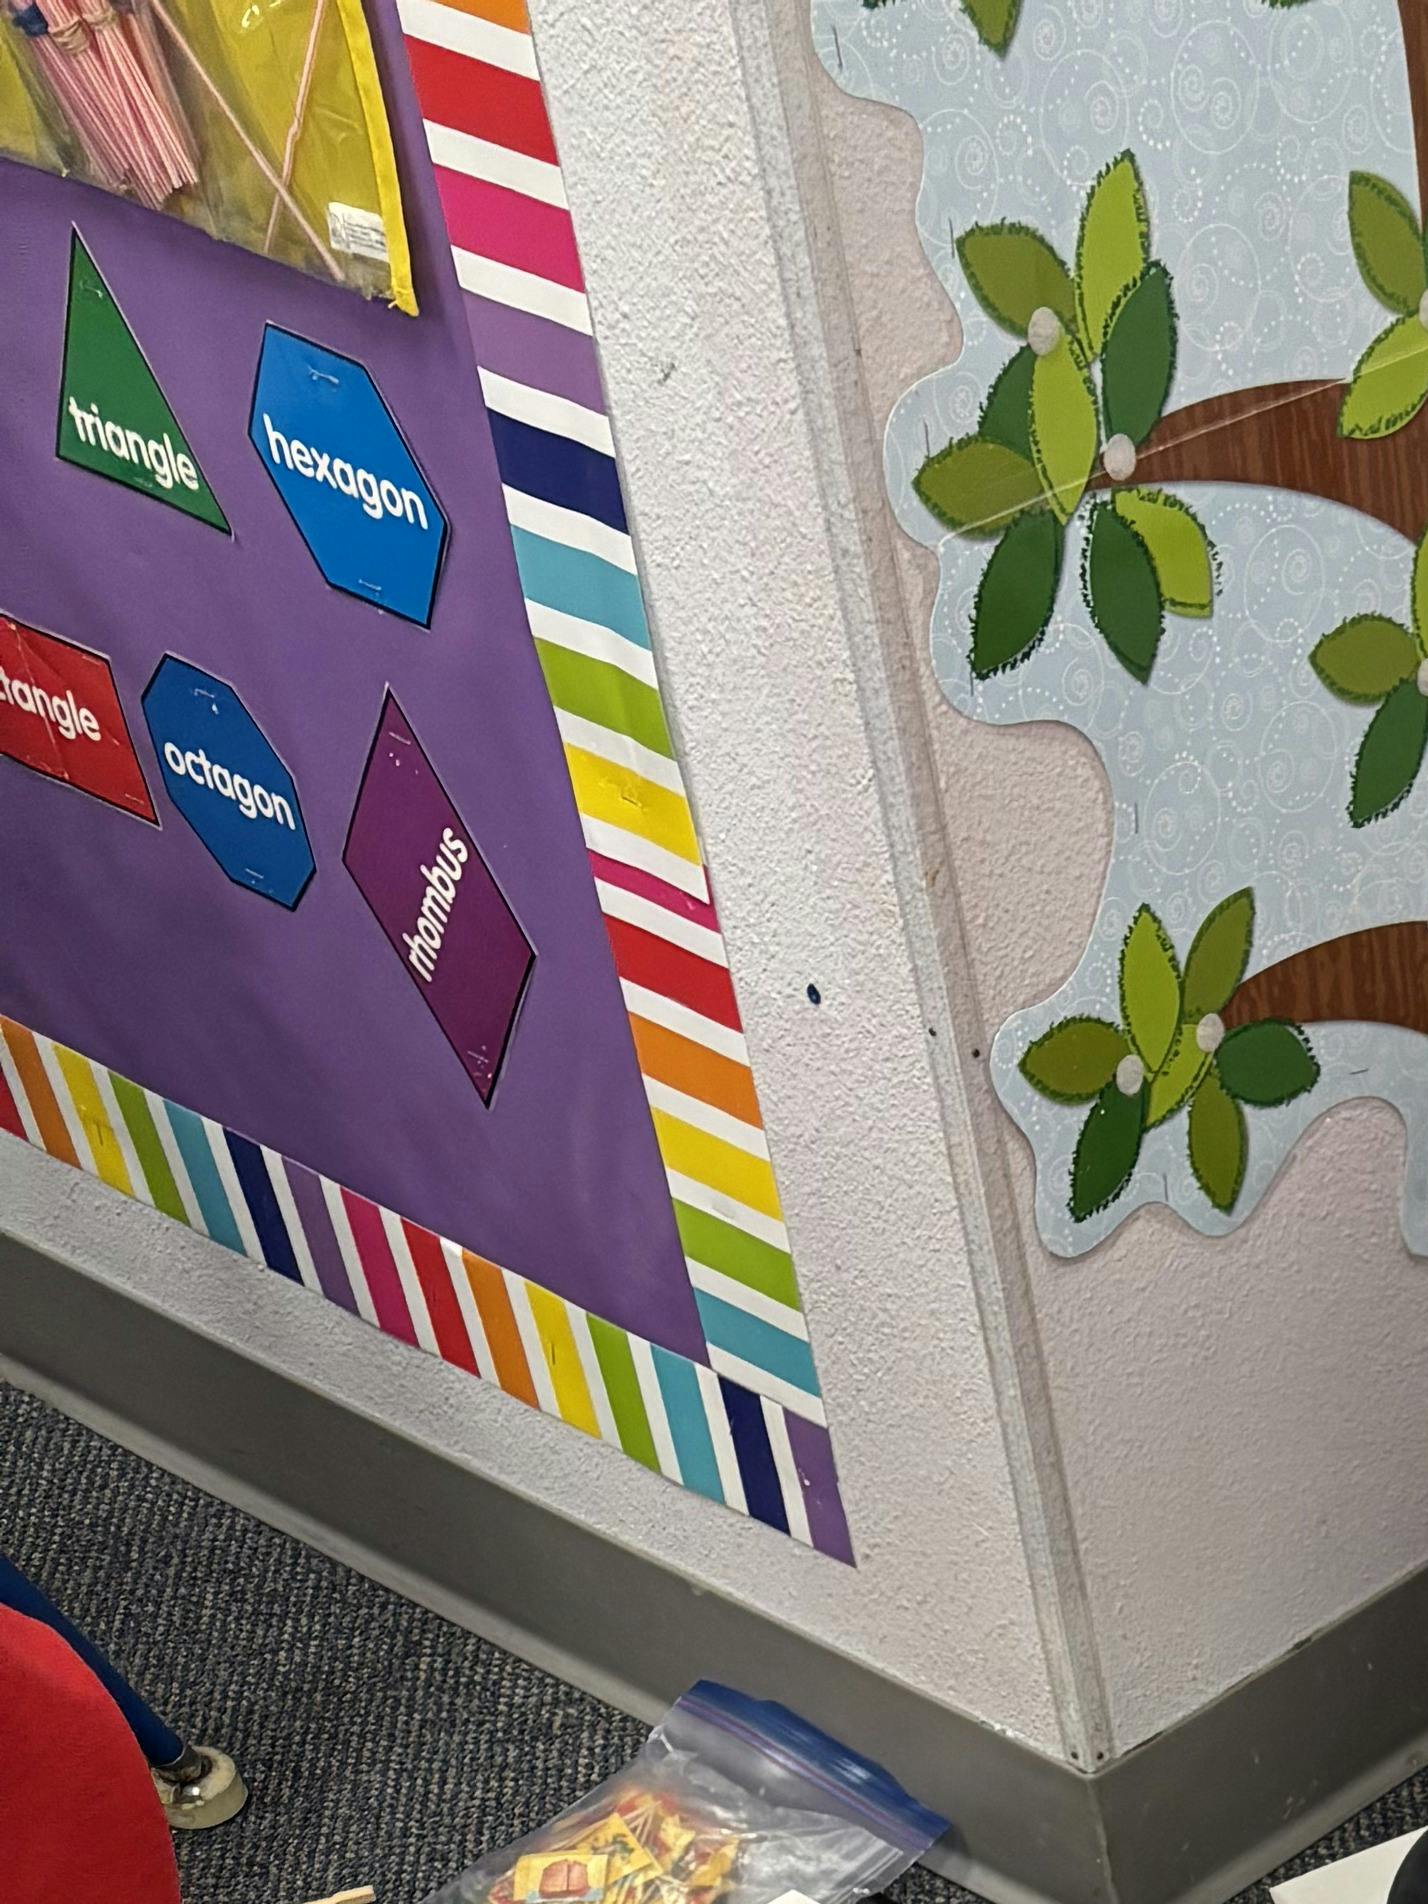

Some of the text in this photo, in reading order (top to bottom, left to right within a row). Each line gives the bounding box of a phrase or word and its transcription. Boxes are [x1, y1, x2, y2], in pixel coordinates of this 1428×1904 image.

[68, 397, 199, 490] triangle
[262, 413, 429, 530] hexagon
[0, 665, 101, 742] tangle
[163, 742, 297, 830] octagon
[406, 828, 470, 984] rhombus
